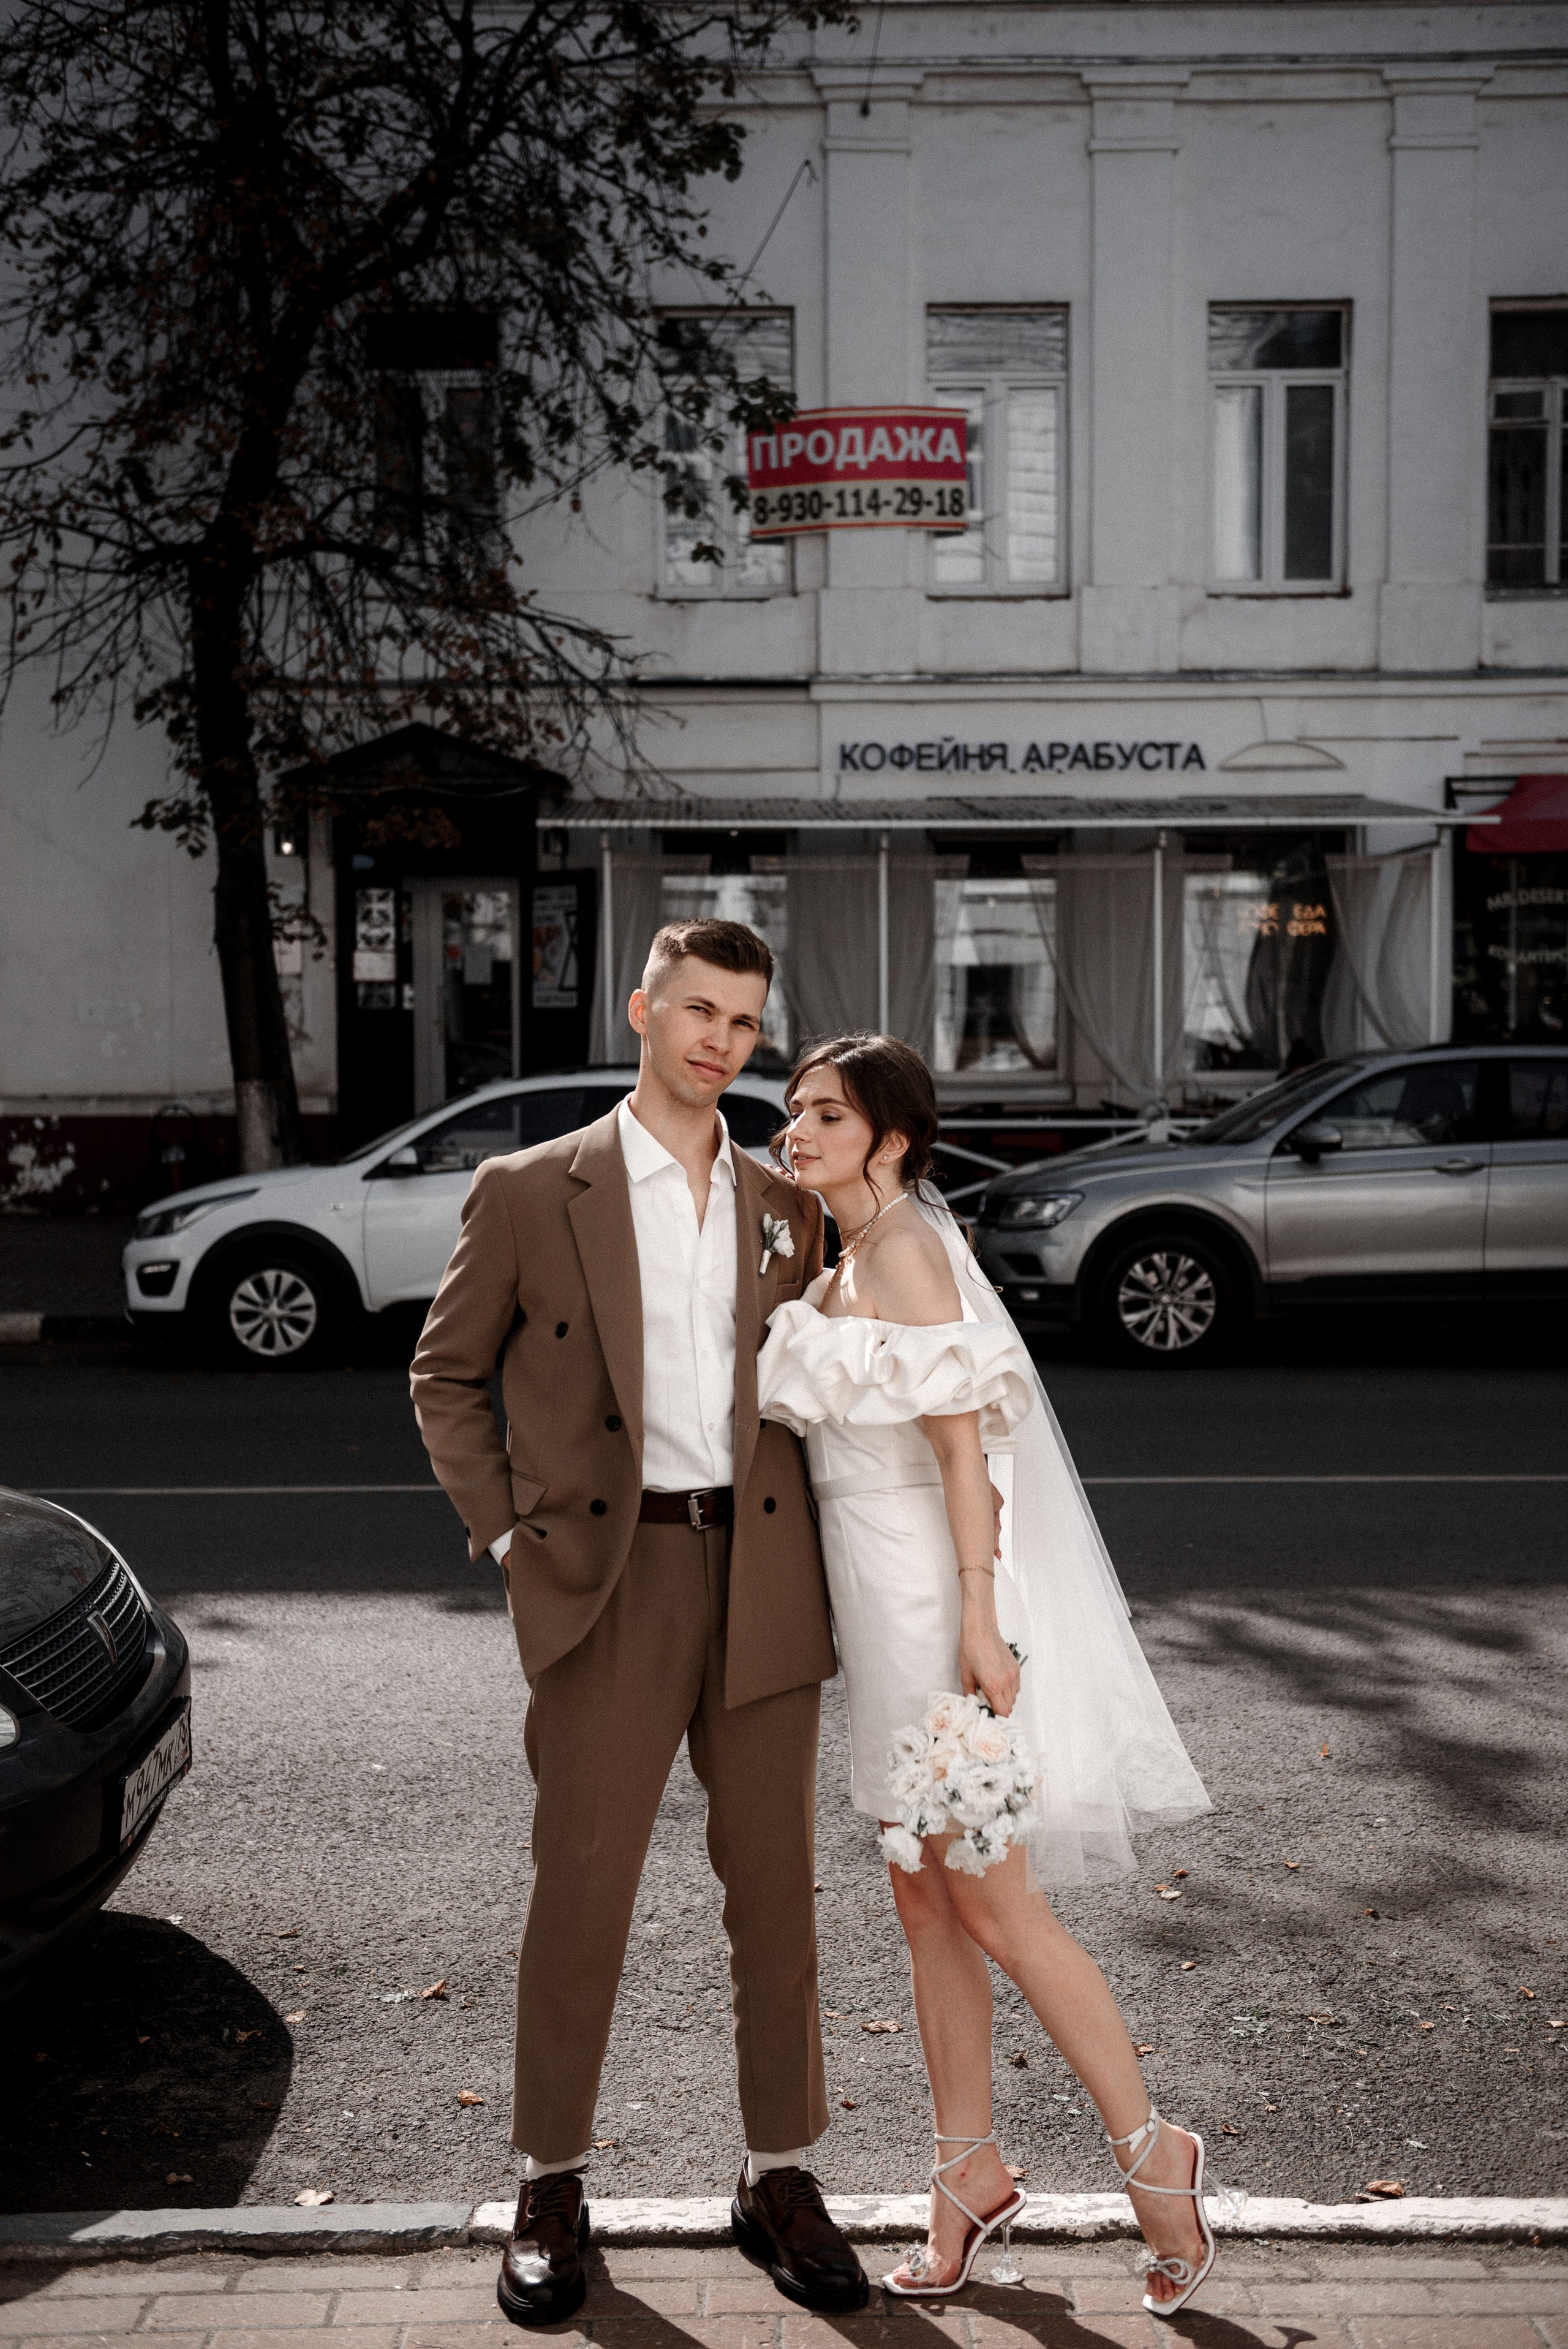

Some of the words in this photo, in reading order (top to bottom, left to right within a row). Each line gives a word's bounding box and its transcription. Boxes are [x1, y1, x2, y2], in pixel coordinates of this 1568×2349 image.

[752, 426, 963, 471] ПРОДАЖА
[753, 487, 964, 525] 8-930-114-29-18
[839, 735, 1008, 771] КОФЕЙНЯ
[1021, 742, 1207, 772] АРАБУСТА
